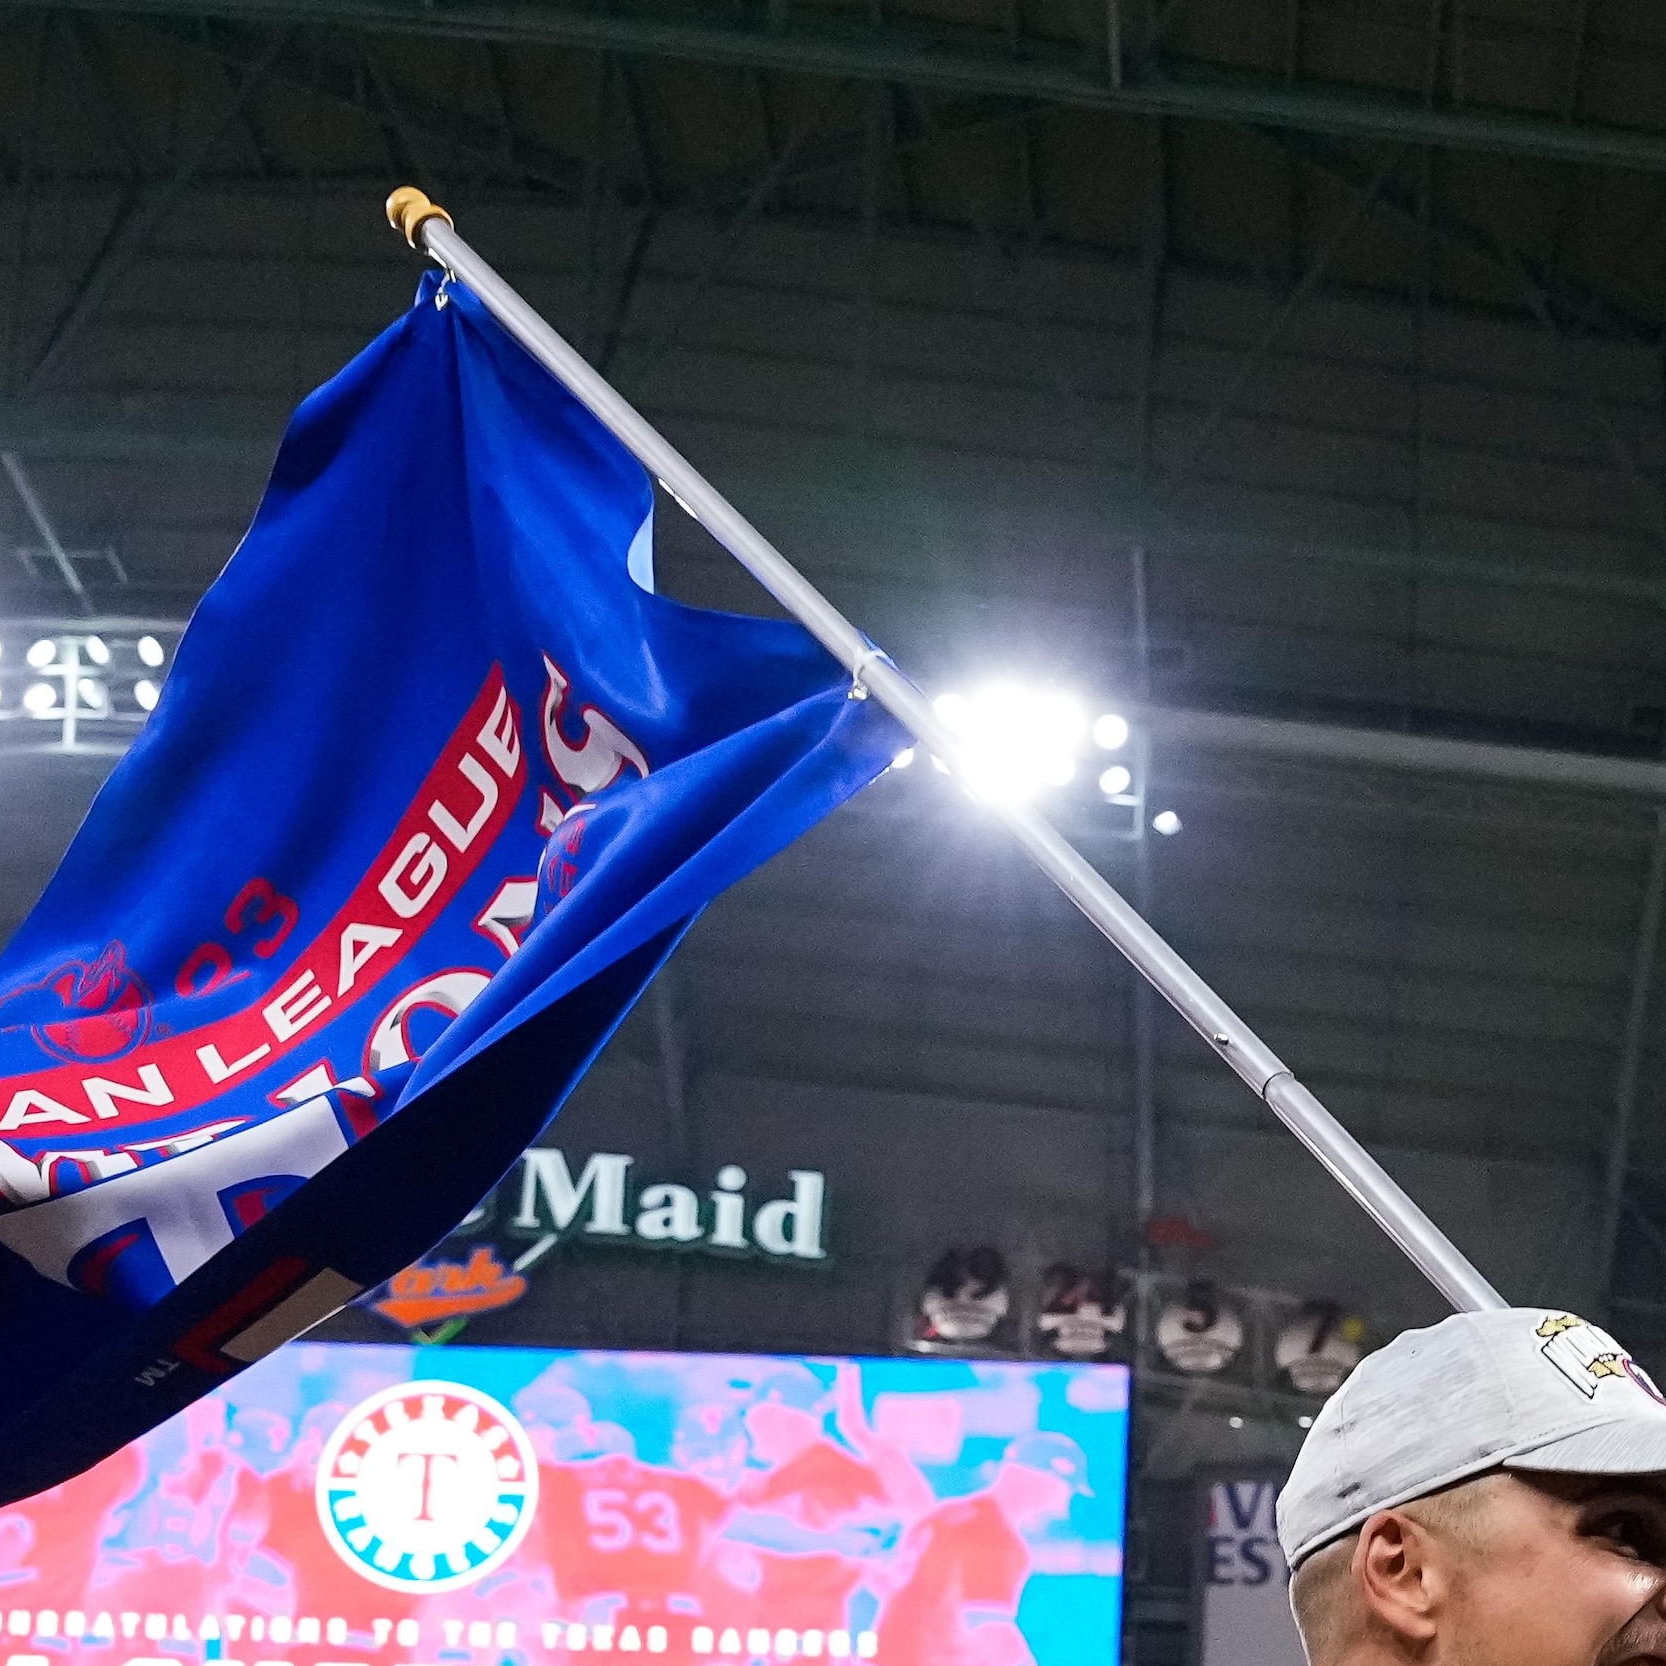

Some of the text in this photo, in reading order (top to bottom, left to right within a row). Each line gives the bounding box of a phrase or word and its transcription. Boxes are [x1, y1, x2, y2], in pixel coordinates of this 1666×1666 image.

[197, 685, 522, 1085] LEAGUE
[513, 1146, 828, 1260] Maid
[581, 1489, 683, 1555] 53
